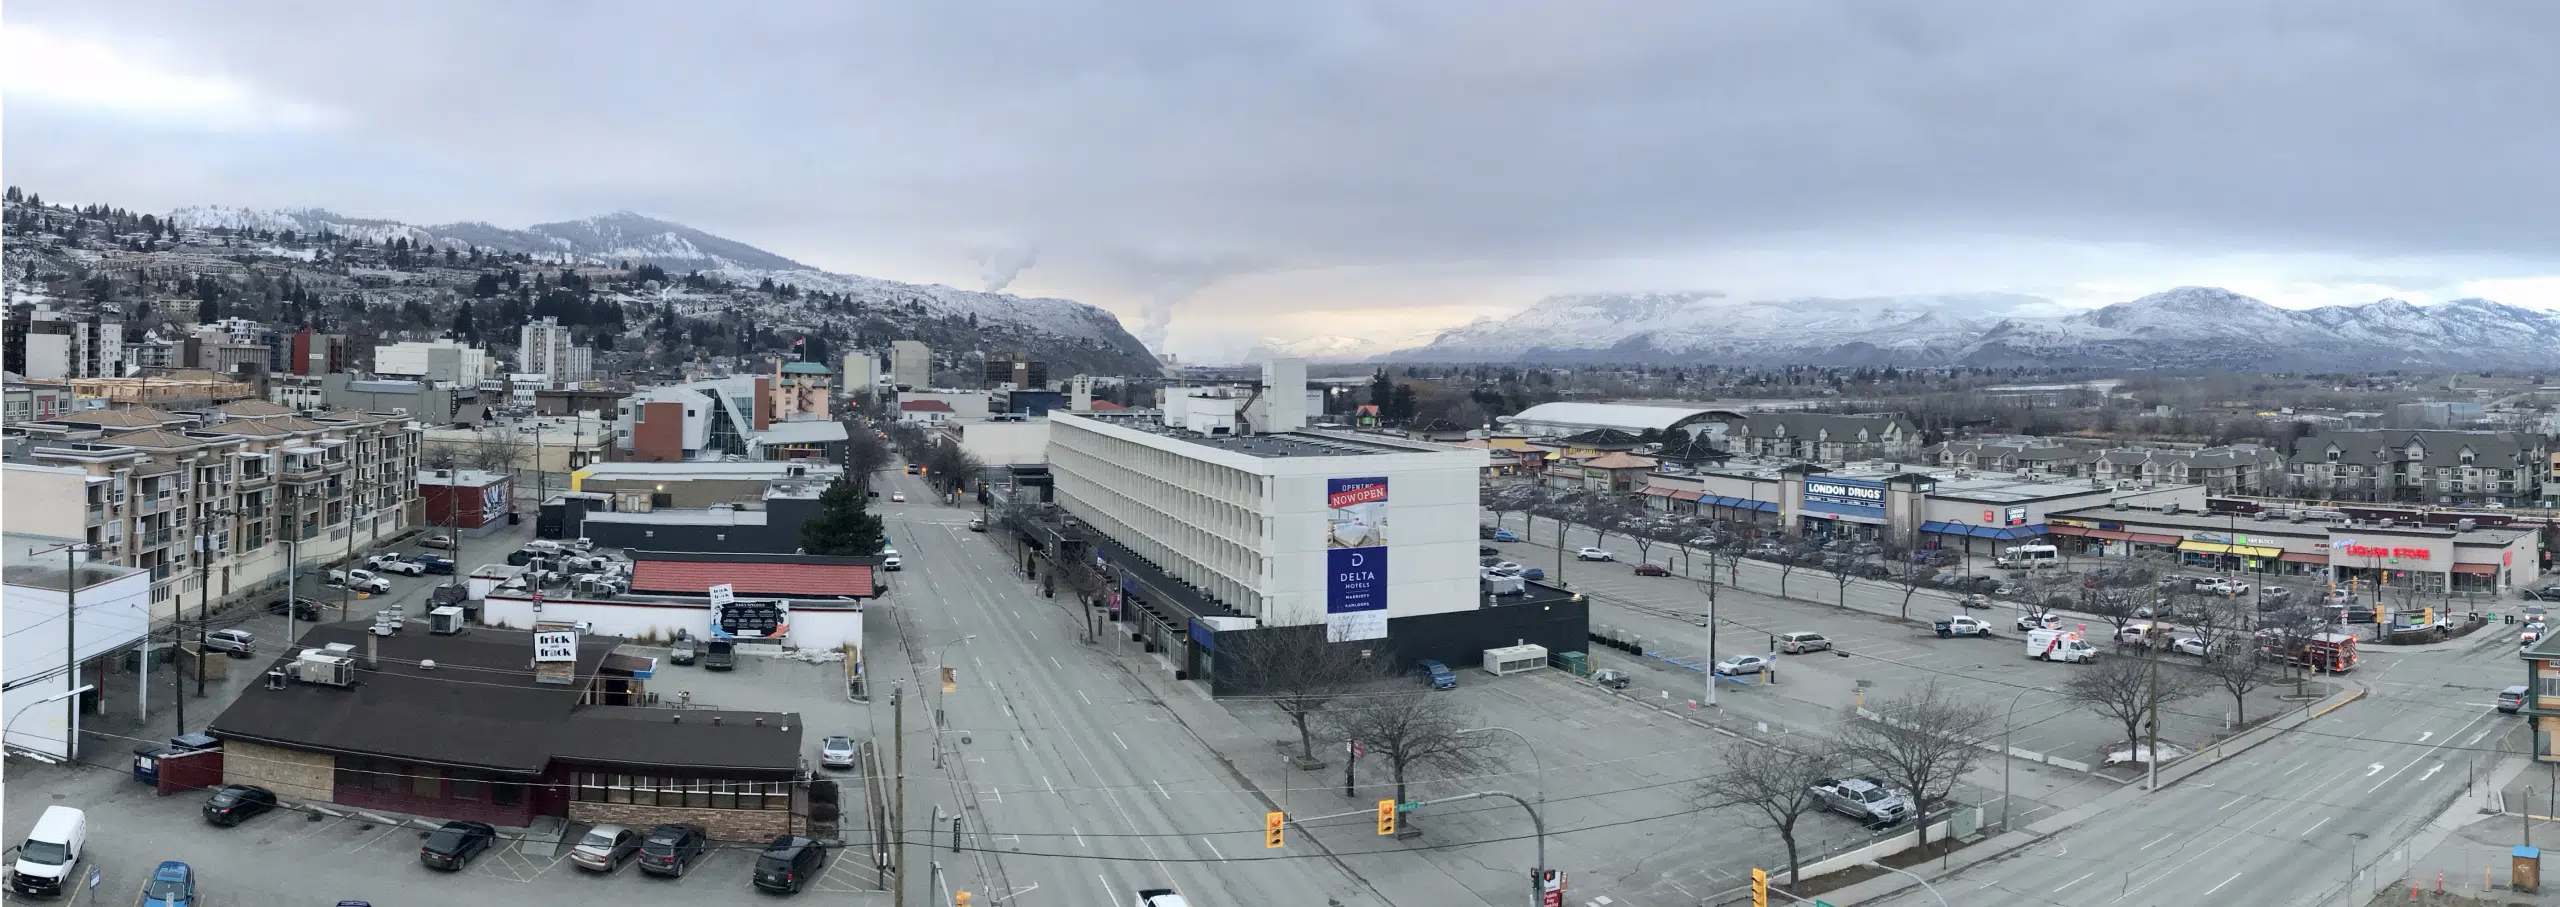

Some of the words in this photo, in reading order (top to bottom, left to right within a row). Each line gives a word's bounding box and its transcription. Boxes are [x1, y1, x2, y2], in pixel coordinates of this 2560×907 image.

[1332, 493, 1356, 506] NOW
[1357, 487, 1384, 501] OPEN
[1808, 483, 1845, 496] LONDON
[1848, 487, 1881, 499] DRUGS
[2345, 544, 2389, 557] LIQUOR
[2392, 547, 2430, 560] STORE
[1340, 571, 1375, 582] DELTA
[540, 635, 571, 644] frick
[540, 648, 571, 657] frack
